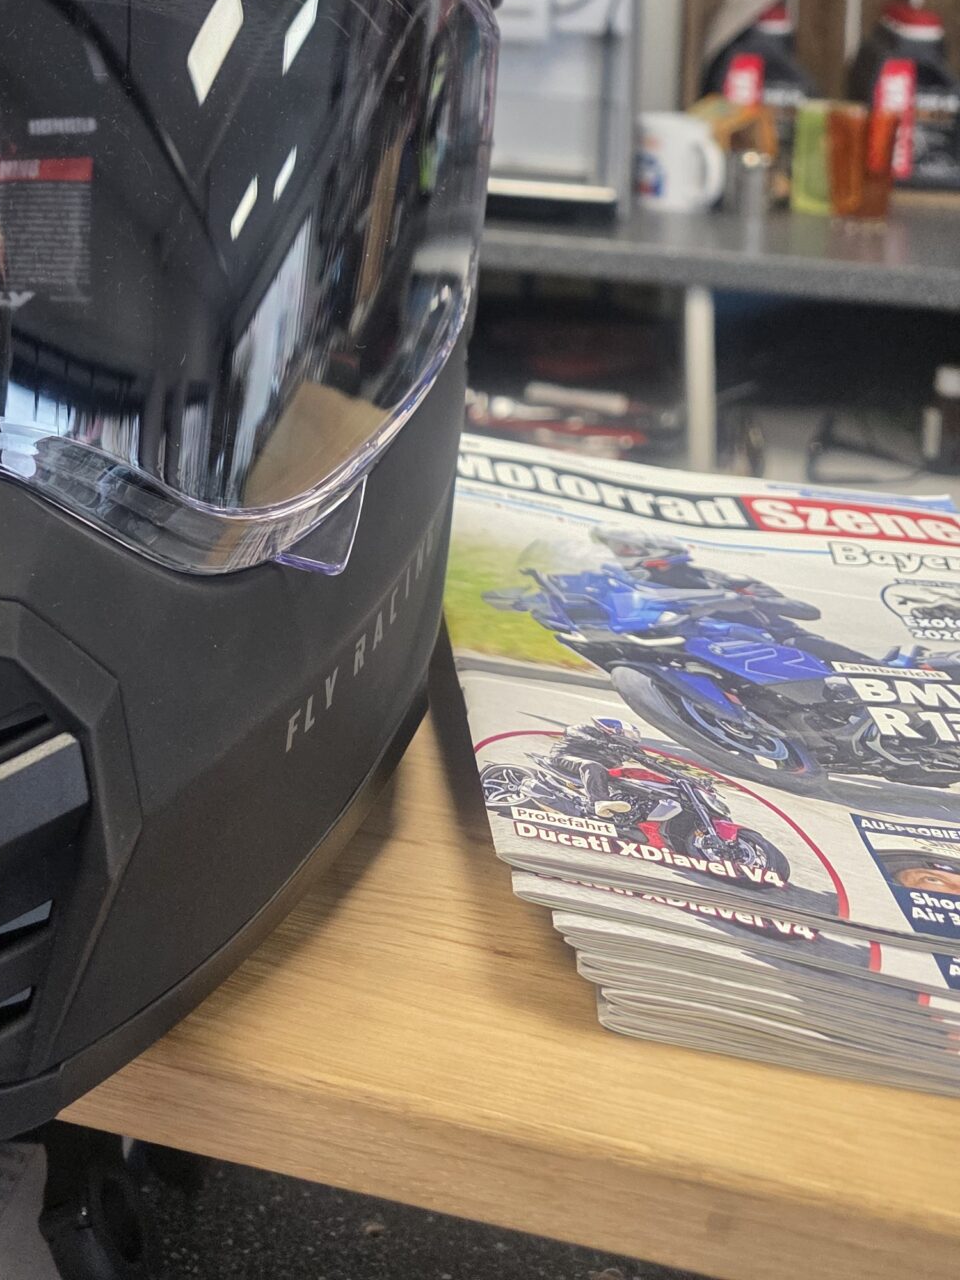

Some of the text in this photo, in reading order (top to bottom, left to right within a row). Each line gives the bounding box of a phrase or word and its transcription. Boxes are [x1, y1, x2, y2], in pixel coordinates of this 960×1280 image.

[839, 662, 946, 678] Fahrbericht
[848, 677, 960, 709] BM
[286, 666, 339, 753] FLY
[867, 706, 926, 739] R
[516, 808, 612, 834] Probefahrt
[515, 821, 786, 887] Ducati XDiavel V4
[912, 907, 945, 923] Air
